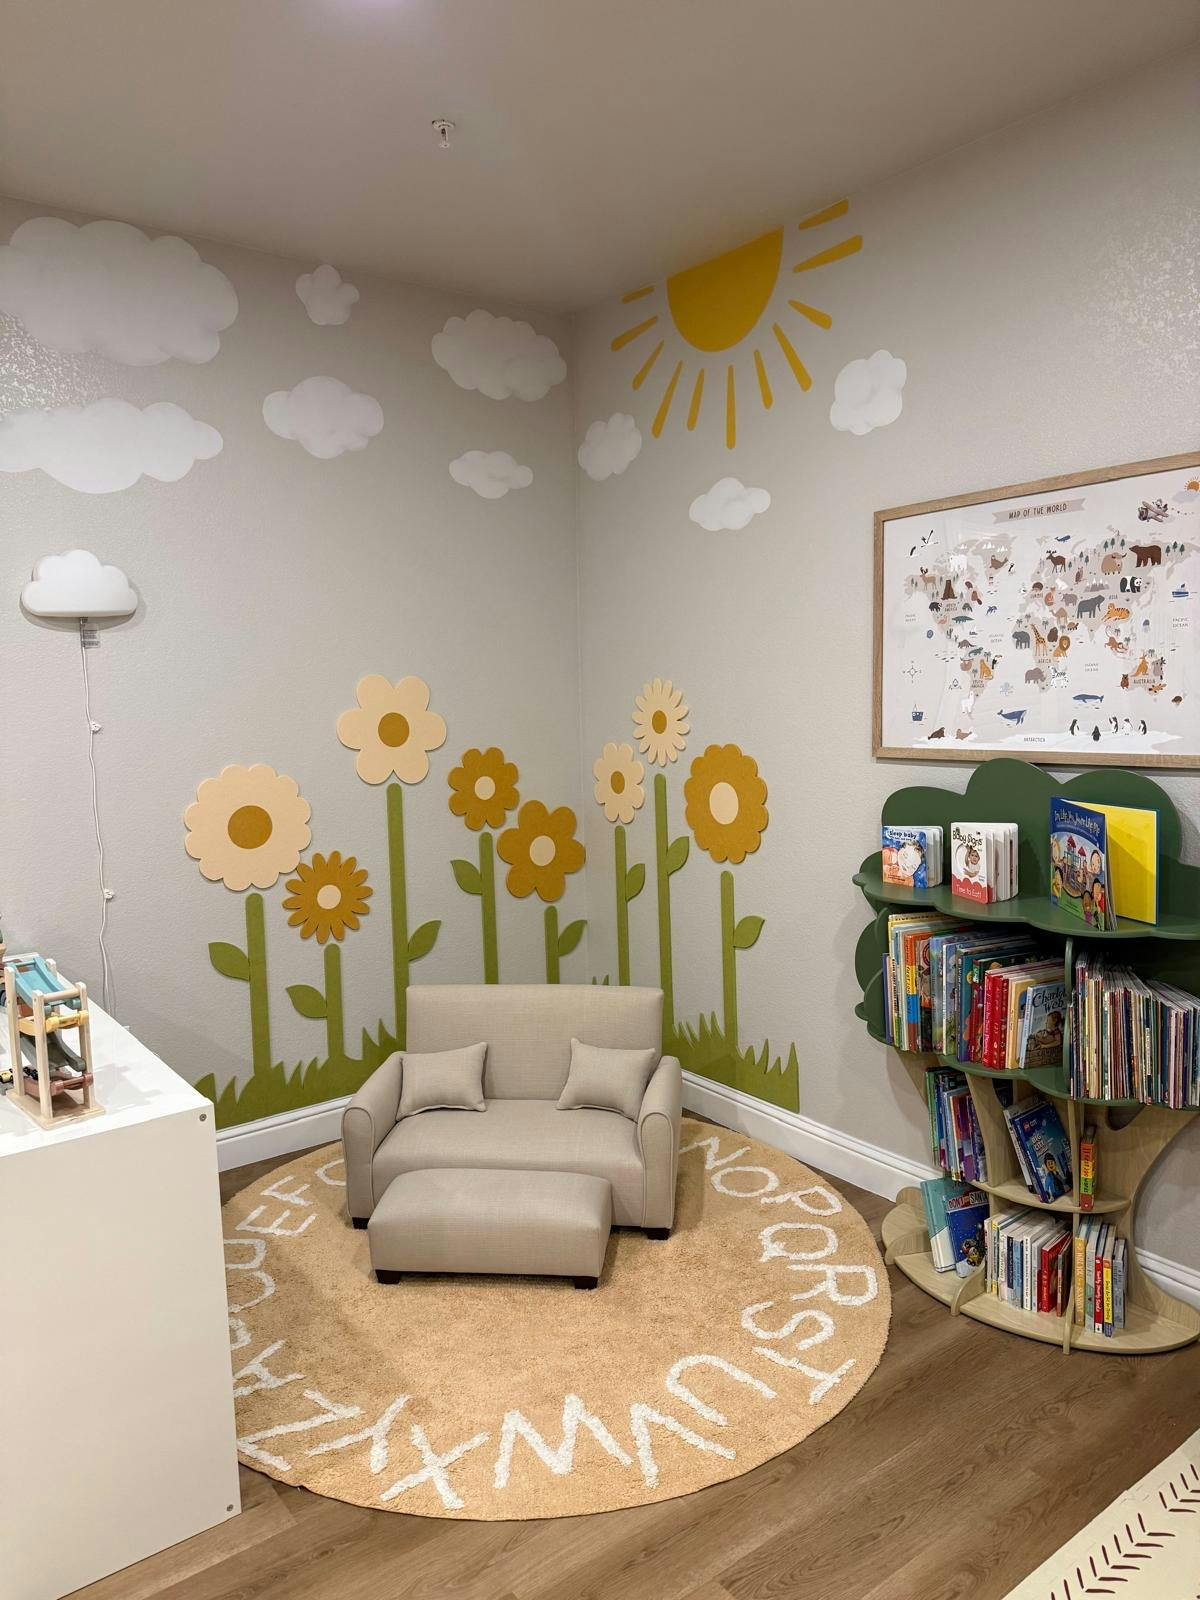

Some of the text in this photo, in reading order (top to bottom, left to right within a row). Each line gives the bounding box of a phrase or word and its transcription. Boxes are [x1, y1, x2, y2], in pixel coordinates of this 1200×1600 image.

[1023, 508, 1030, 517] OF
[1033, 506, 1044, 515] THE
[1046, 503, 1067, 514] WORLD
[903, 831, 917, 840] baby
[953, 829, 983, 847] Baby Signs
